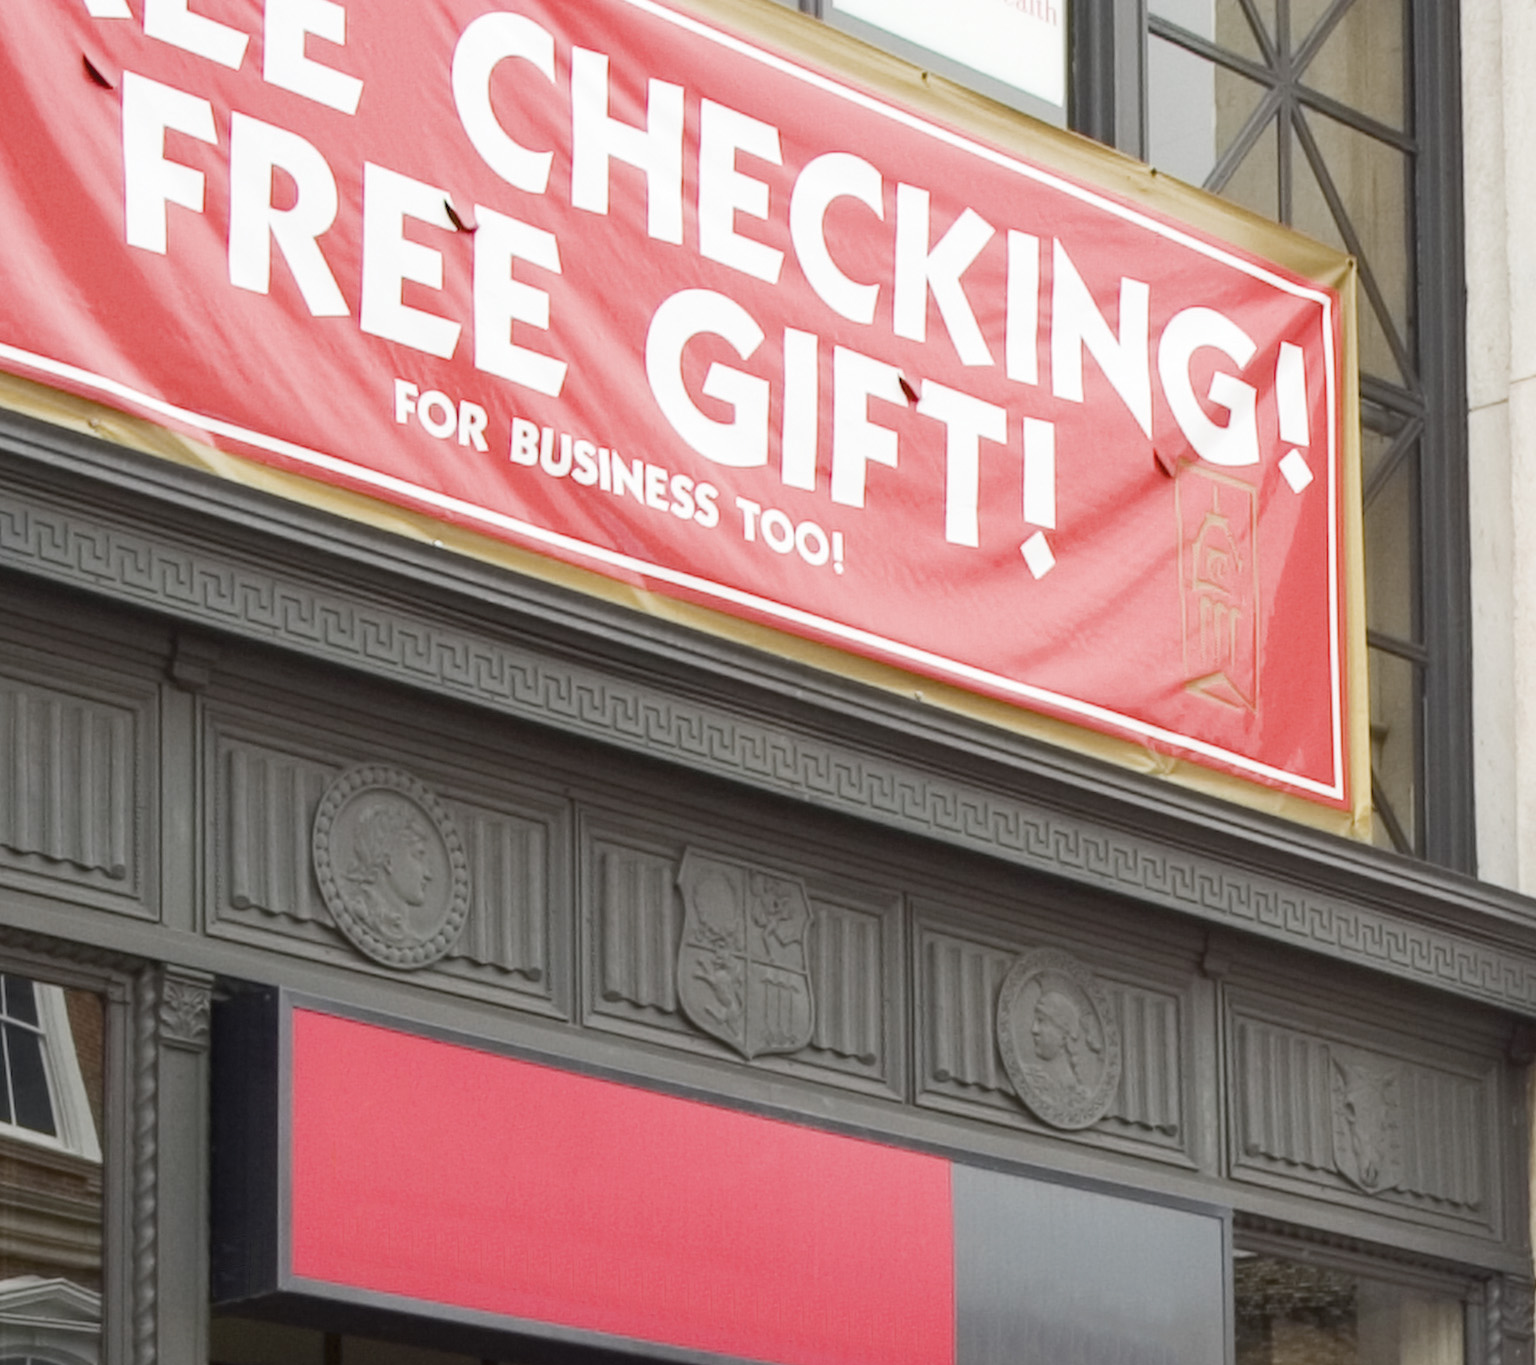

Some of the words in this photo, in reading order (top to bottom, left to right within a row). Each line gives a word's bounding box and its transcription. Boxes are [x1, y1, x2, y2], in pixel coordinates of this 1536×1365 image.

[121, 69, 568, 398] FREE
[644, 288, 1056, 581] GIFT!
[393, 377, 489, 453] FOR
[509, 416, 720, 529] BUSINESS
[735, 496, 846, 576] TOO!
[451, 11, 1314, 494] CHECKING!
